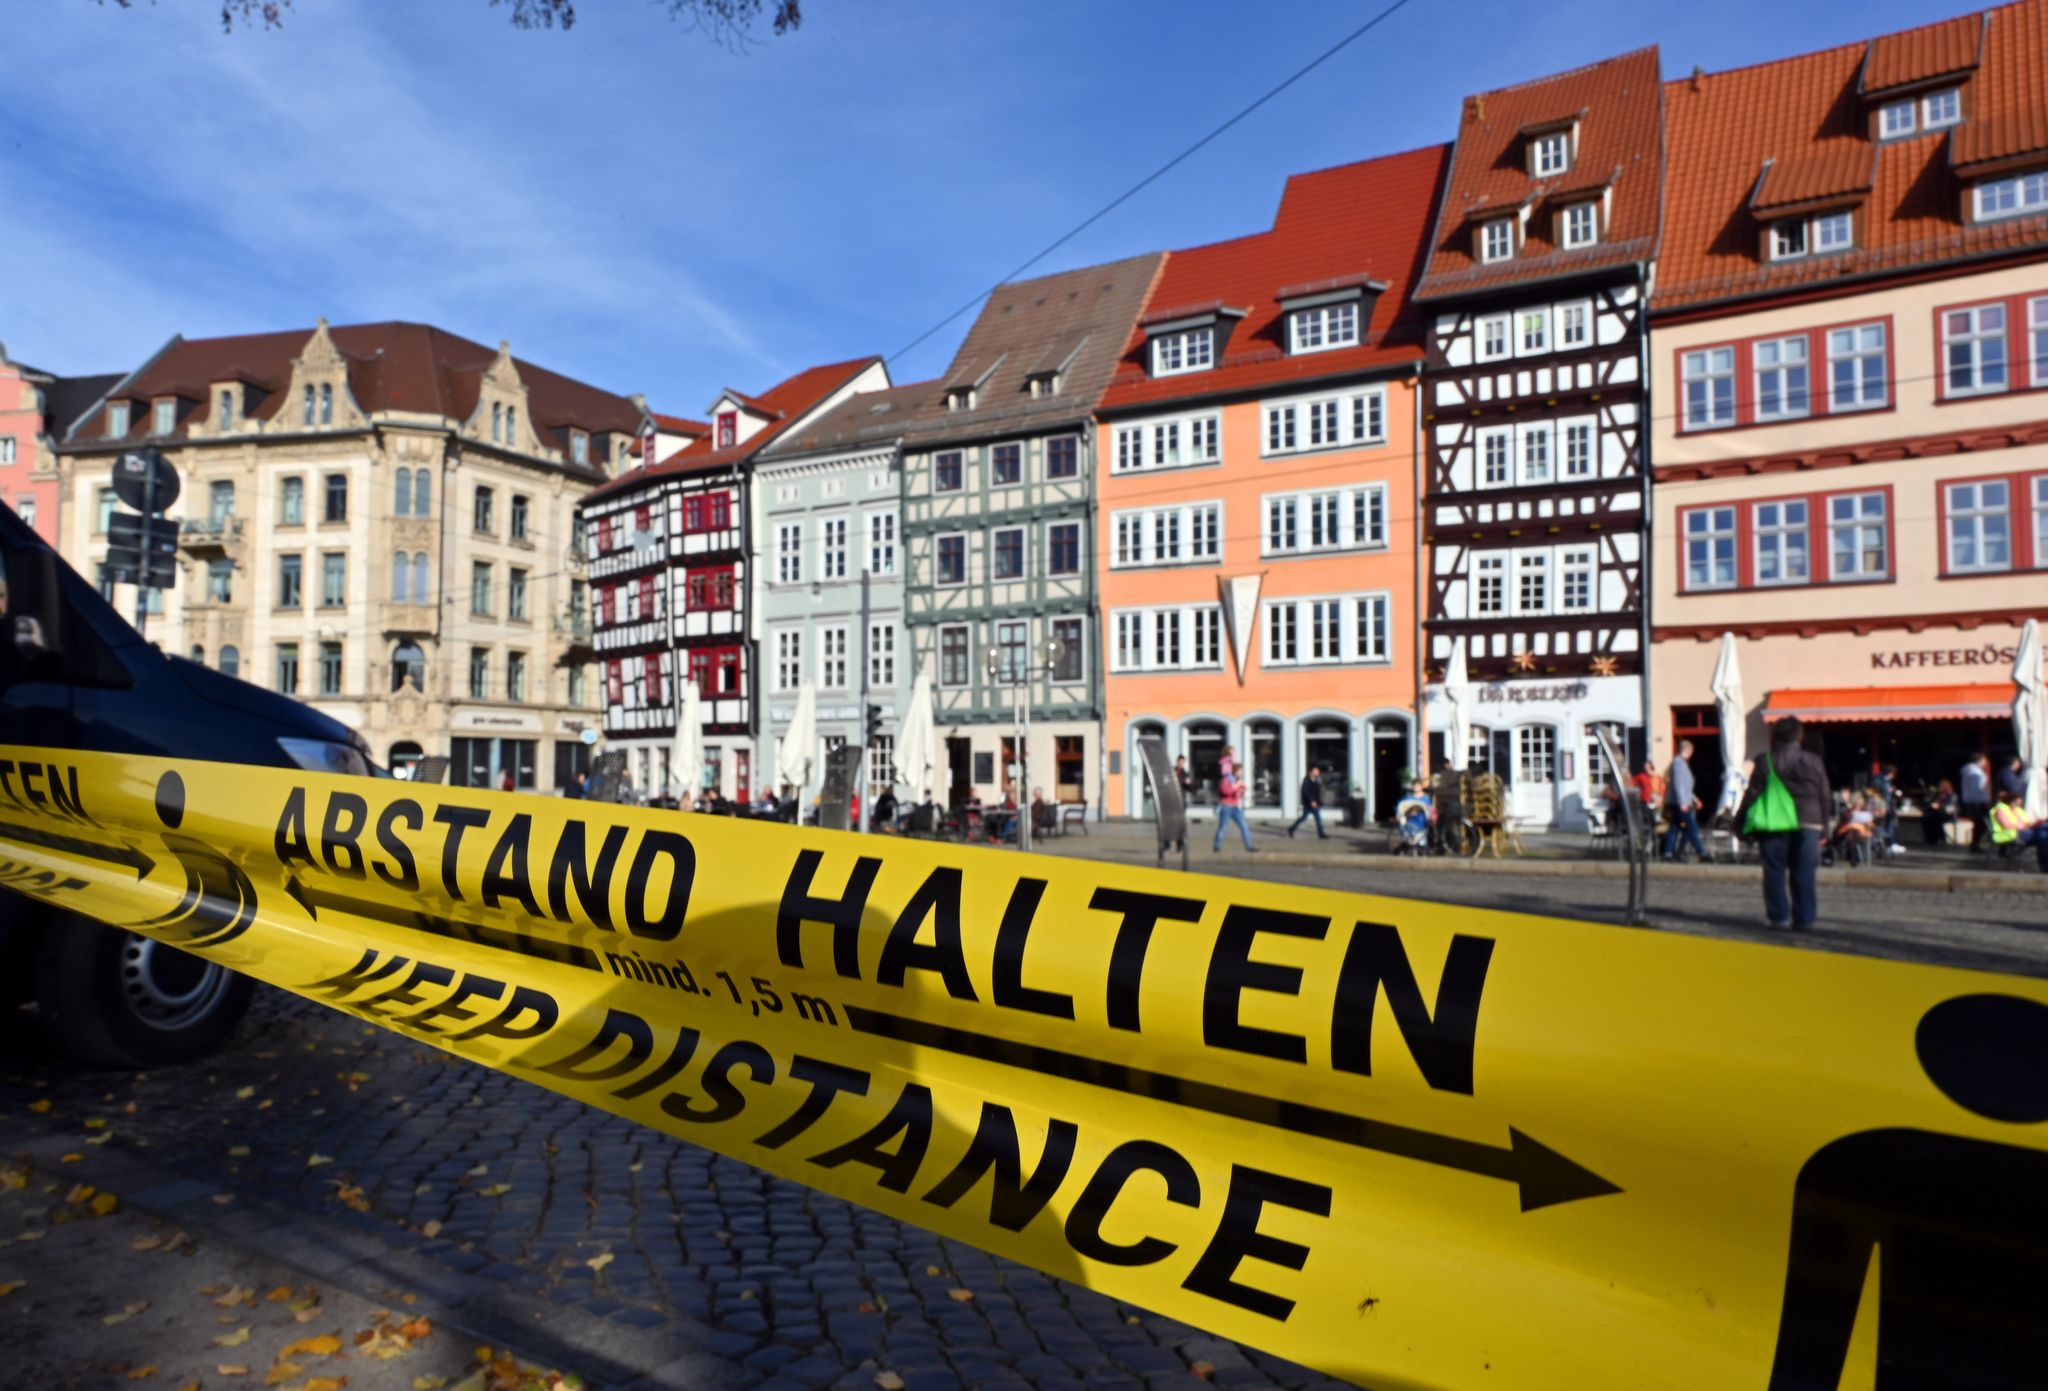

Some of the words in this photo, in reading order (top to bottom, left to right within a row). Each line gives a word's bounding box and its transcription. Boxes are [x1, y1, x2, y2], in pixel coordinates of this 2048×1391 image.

[1871, 643, 2048, 669] KAFFEERÖS
[274, 786, 697, 941] ABSTAND
[776, 848, 1496, 1095] HALTEN
[603, 950, 712, 998] mind.
[715, 970, 784, 1017] 1,5
[790, 991, 839, 1026] m
[294, 947, 559, 1041] KEEP
[534, 1008, 1333, 1322] DISTANCE
